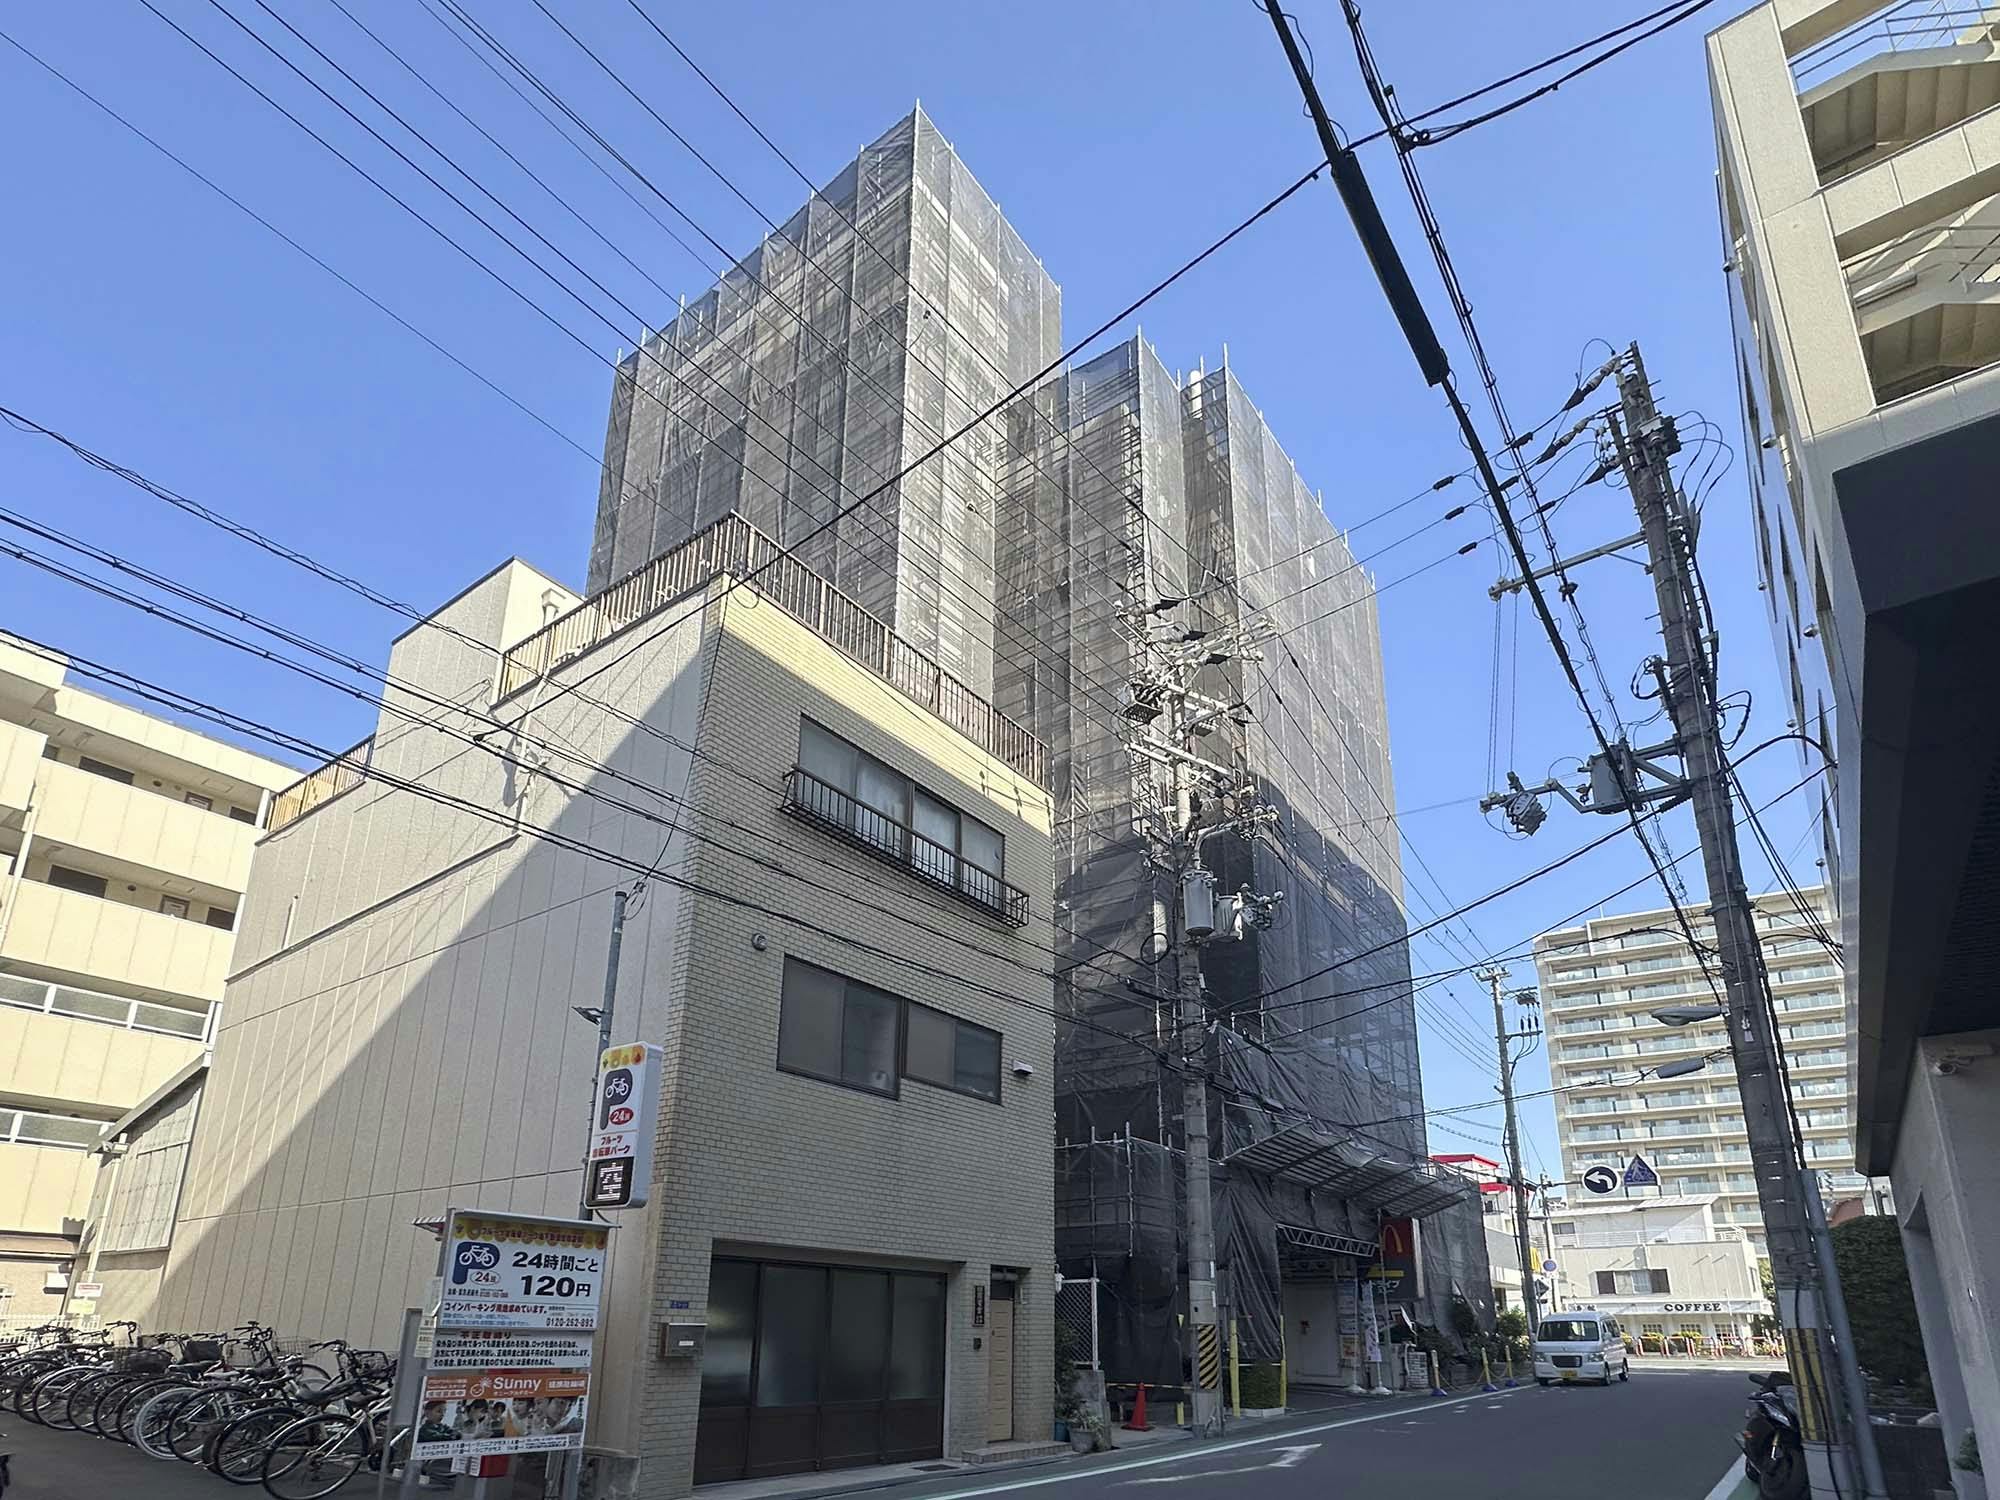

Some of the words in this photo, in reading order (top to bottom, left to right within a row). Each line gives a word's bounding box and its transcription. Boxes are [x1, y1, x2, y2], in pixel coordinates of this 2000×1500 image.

[601, 1135, 623, 1145] フルーツ
[593, 1145, 630, 1158] 自転車パーク
[597, 1163, 623, 1200] 空
[512, 1252, 599, 1273] 24時間ごと
[521, 1275, 591, 1297] 120円
[1664, 1303, 1721, 1312] COFFEE
[493, 1377, 542, 1392] Sunny
